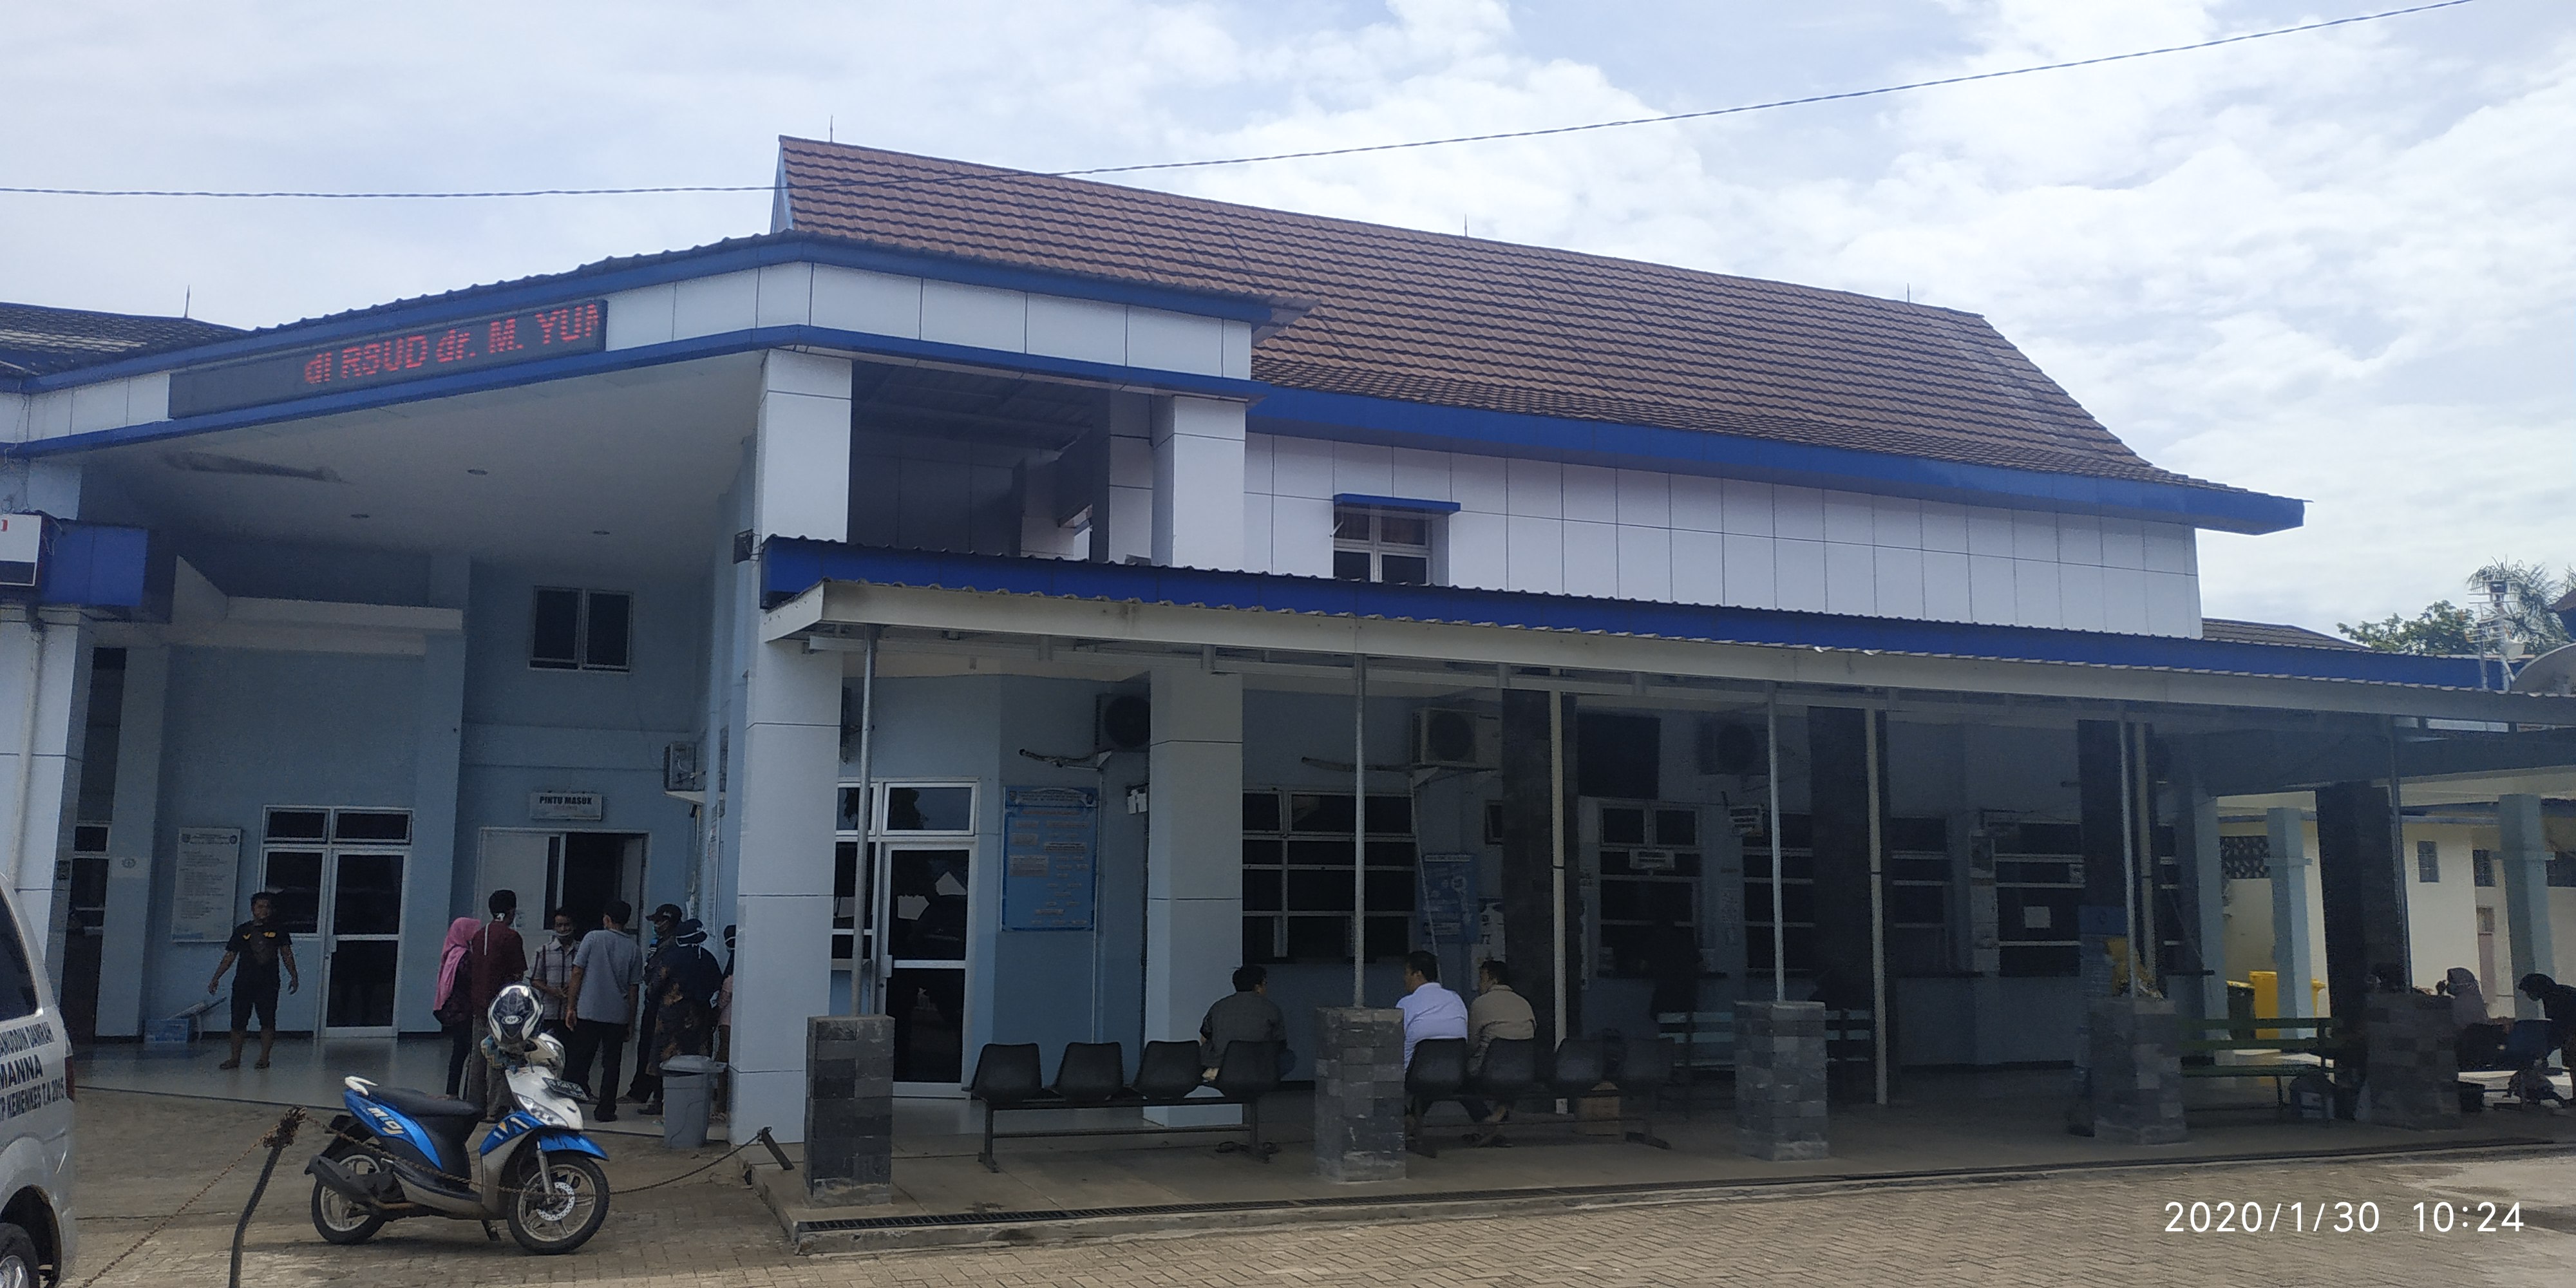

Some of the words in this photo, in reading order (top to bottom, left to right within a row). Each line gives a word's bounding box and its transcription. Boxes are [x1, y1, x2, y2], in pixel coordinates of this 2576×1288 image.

[435, 329, 477, 363] dr.
[489, 318, 524, 354] M.
[539, 796, 564, 804] PINTU
[564, 796, 592, 805] MASUK
[0, 1054, 43, 1090] MANNA
